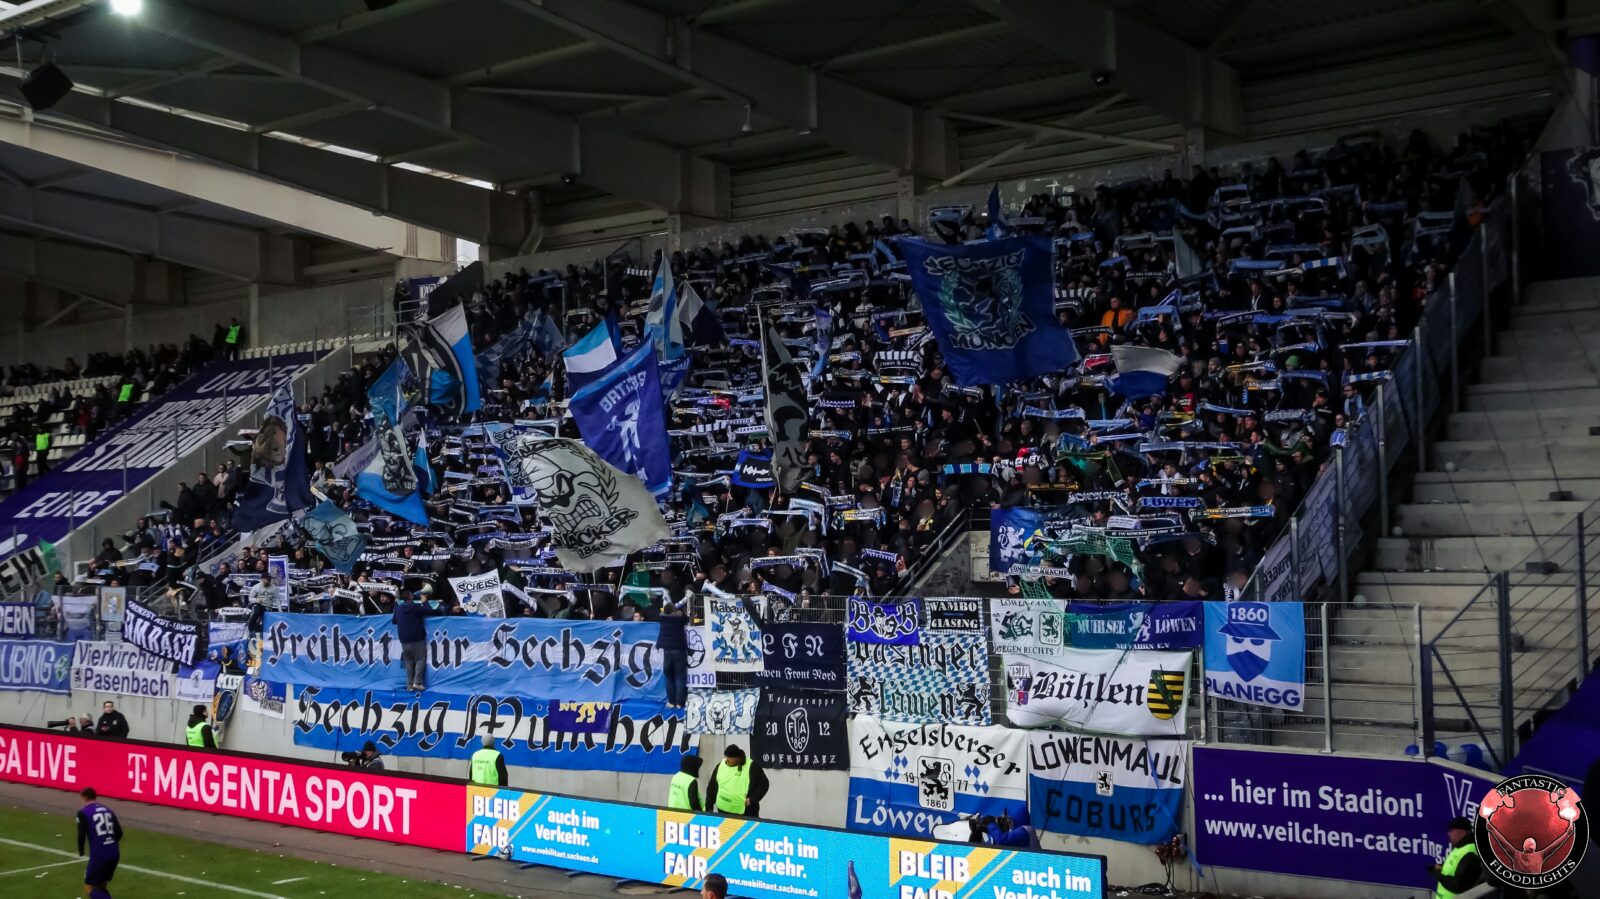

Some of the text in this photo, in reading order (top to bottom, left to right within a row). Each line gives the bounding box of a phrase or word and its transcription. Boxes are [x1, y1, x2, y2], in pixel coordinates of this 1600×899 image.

[929, 601, 977, 612] WAMBO
[1230, 607, 1268, 622] 1860
[931, 618, 978, 629] GIASING
[1154, 614, 1196, 634] LÖWEN
[79, 643, 167, 672] Vierkirchen
[267, 622, 657, 689] Freiheit ür Sechzig
[996, 645, 1054, 655] GEGEN RECHTS
[84, 668, 169, 696] Pasenbach
[783, 667, 809, 680] Front
[811, 669, 836, 681] Nord
[1032, 671, 1146, 708] Böhlen
[1204, 677, 1301, 706] PLANEGG
[291, 686, 452, 752] Sechzig
[765, 721, 830, 735] 20 12
[790, 736, 806, 749] 1860
[858, 722, 1021, 775] Engelsberger
[27, 740, 77, 783] LIVE
[1029, 734, 1181, 784] LÖWENMAUL
[904, 771, 968, 792] 19 77
[154, 757, 299, 818] MAGENTA
[304, 775, 419, 835] SPORT
[473, 796, 521, 821] BLEIB
[926, 798, 947, 809] 1860
[1231, 778, 1276, 806] hier
[1281, 783, 1310, 810] im
[1317, 786, 1423, 817] Stadion!
[93, 813, 115, 837] 26
[547, 809, 600, 829] auch im
[535, 823, 590, 847] Verkehr.
[665, 822, 722, 849] BLEIB
[755, 836, 819, 859] auch im
[739, 853, 807, 878] Verkehr.
[899, 850, 971, 882] BLEIB
[1011, 866, 1092, 891] auch im
